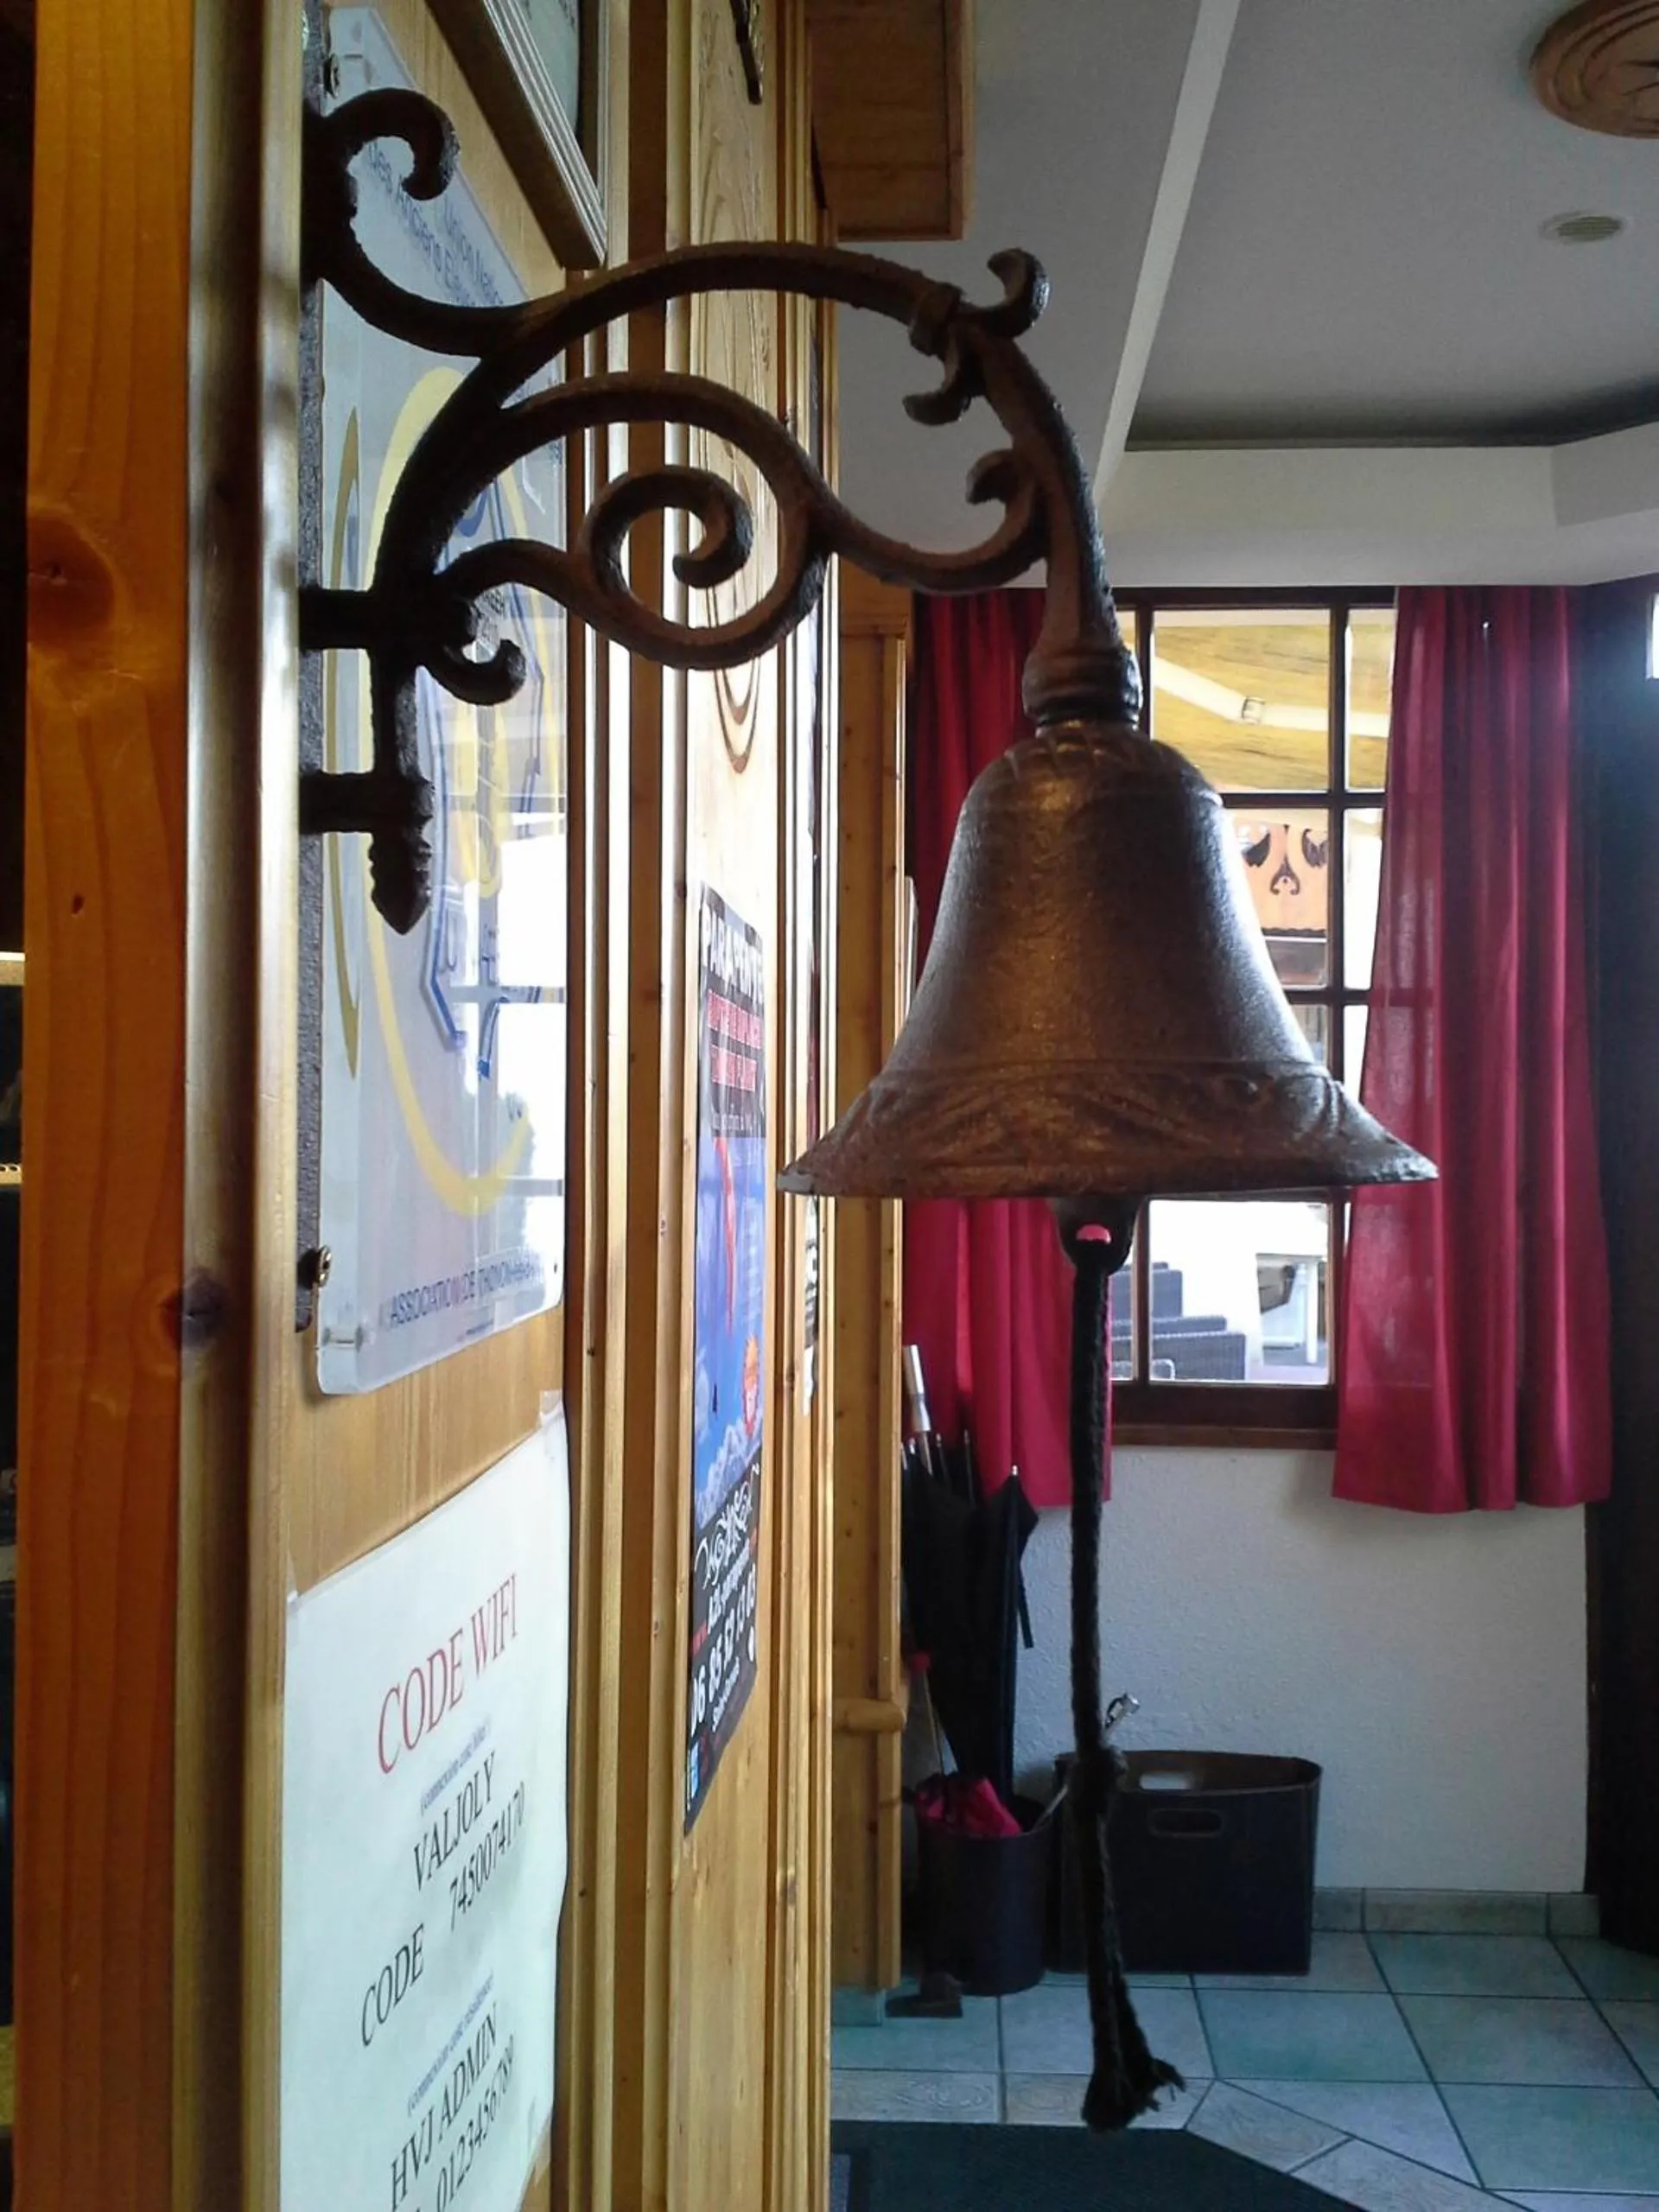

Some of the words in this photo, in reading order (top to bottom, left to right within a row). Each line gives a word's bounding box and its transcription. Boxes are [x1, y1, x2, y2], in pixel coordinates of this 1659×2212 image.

[378, 1628, 463, 1774] CODE
[471, 1573, 517, 1678] WIFI
[414, 1749, 494, 1891] VALJOLY
[362, 1923, 424, 2047] CODE
[391, 2102, 434, 2212] HVJ
[438, 2000, 496, 2145] ADMIN
